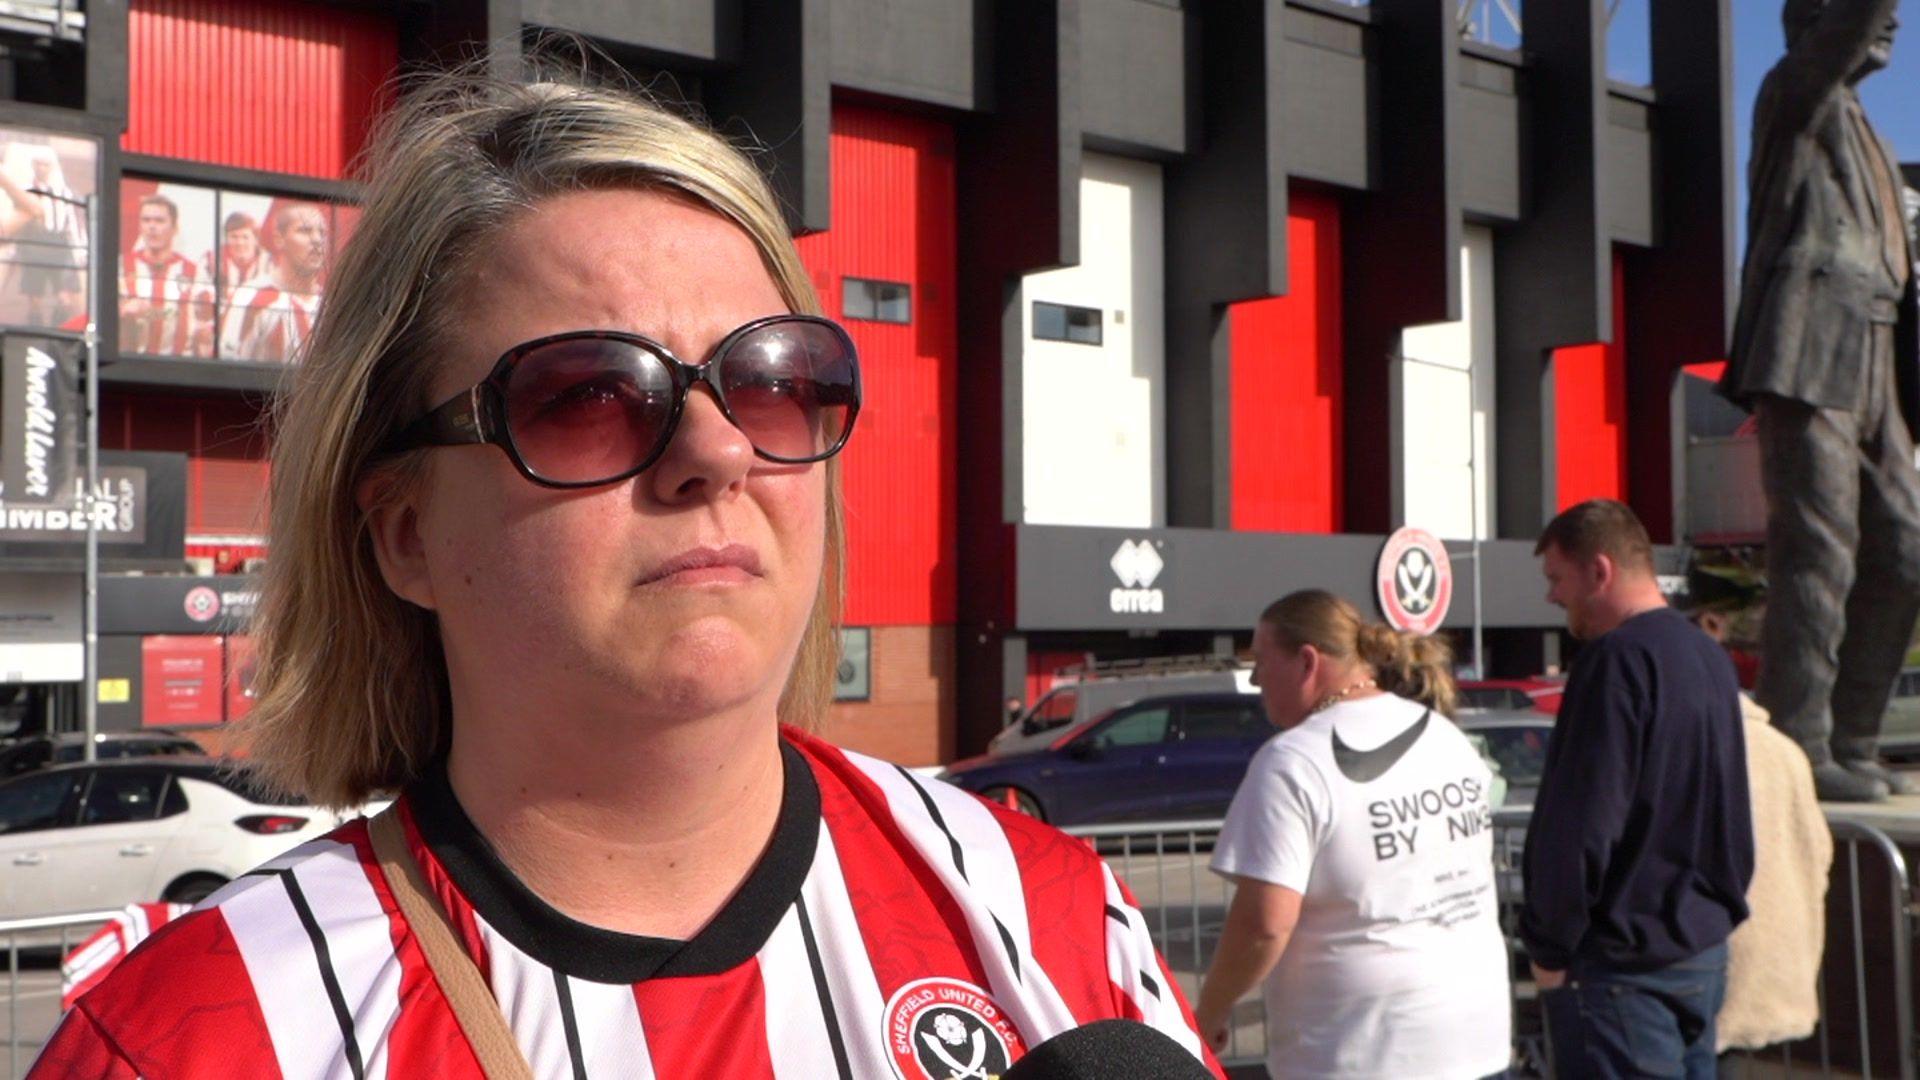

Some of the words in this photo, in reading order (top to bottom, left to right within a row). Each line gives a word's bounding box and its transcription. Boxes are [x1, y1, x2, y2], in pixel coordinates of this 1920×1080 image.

[1369, 777, 1482, 829] SWOOS
[1374, 826, 1418, 861] BY
[895, 989, 934, 1054] SHEFFIELD
[939, 988, 995, 1018] UNITED
